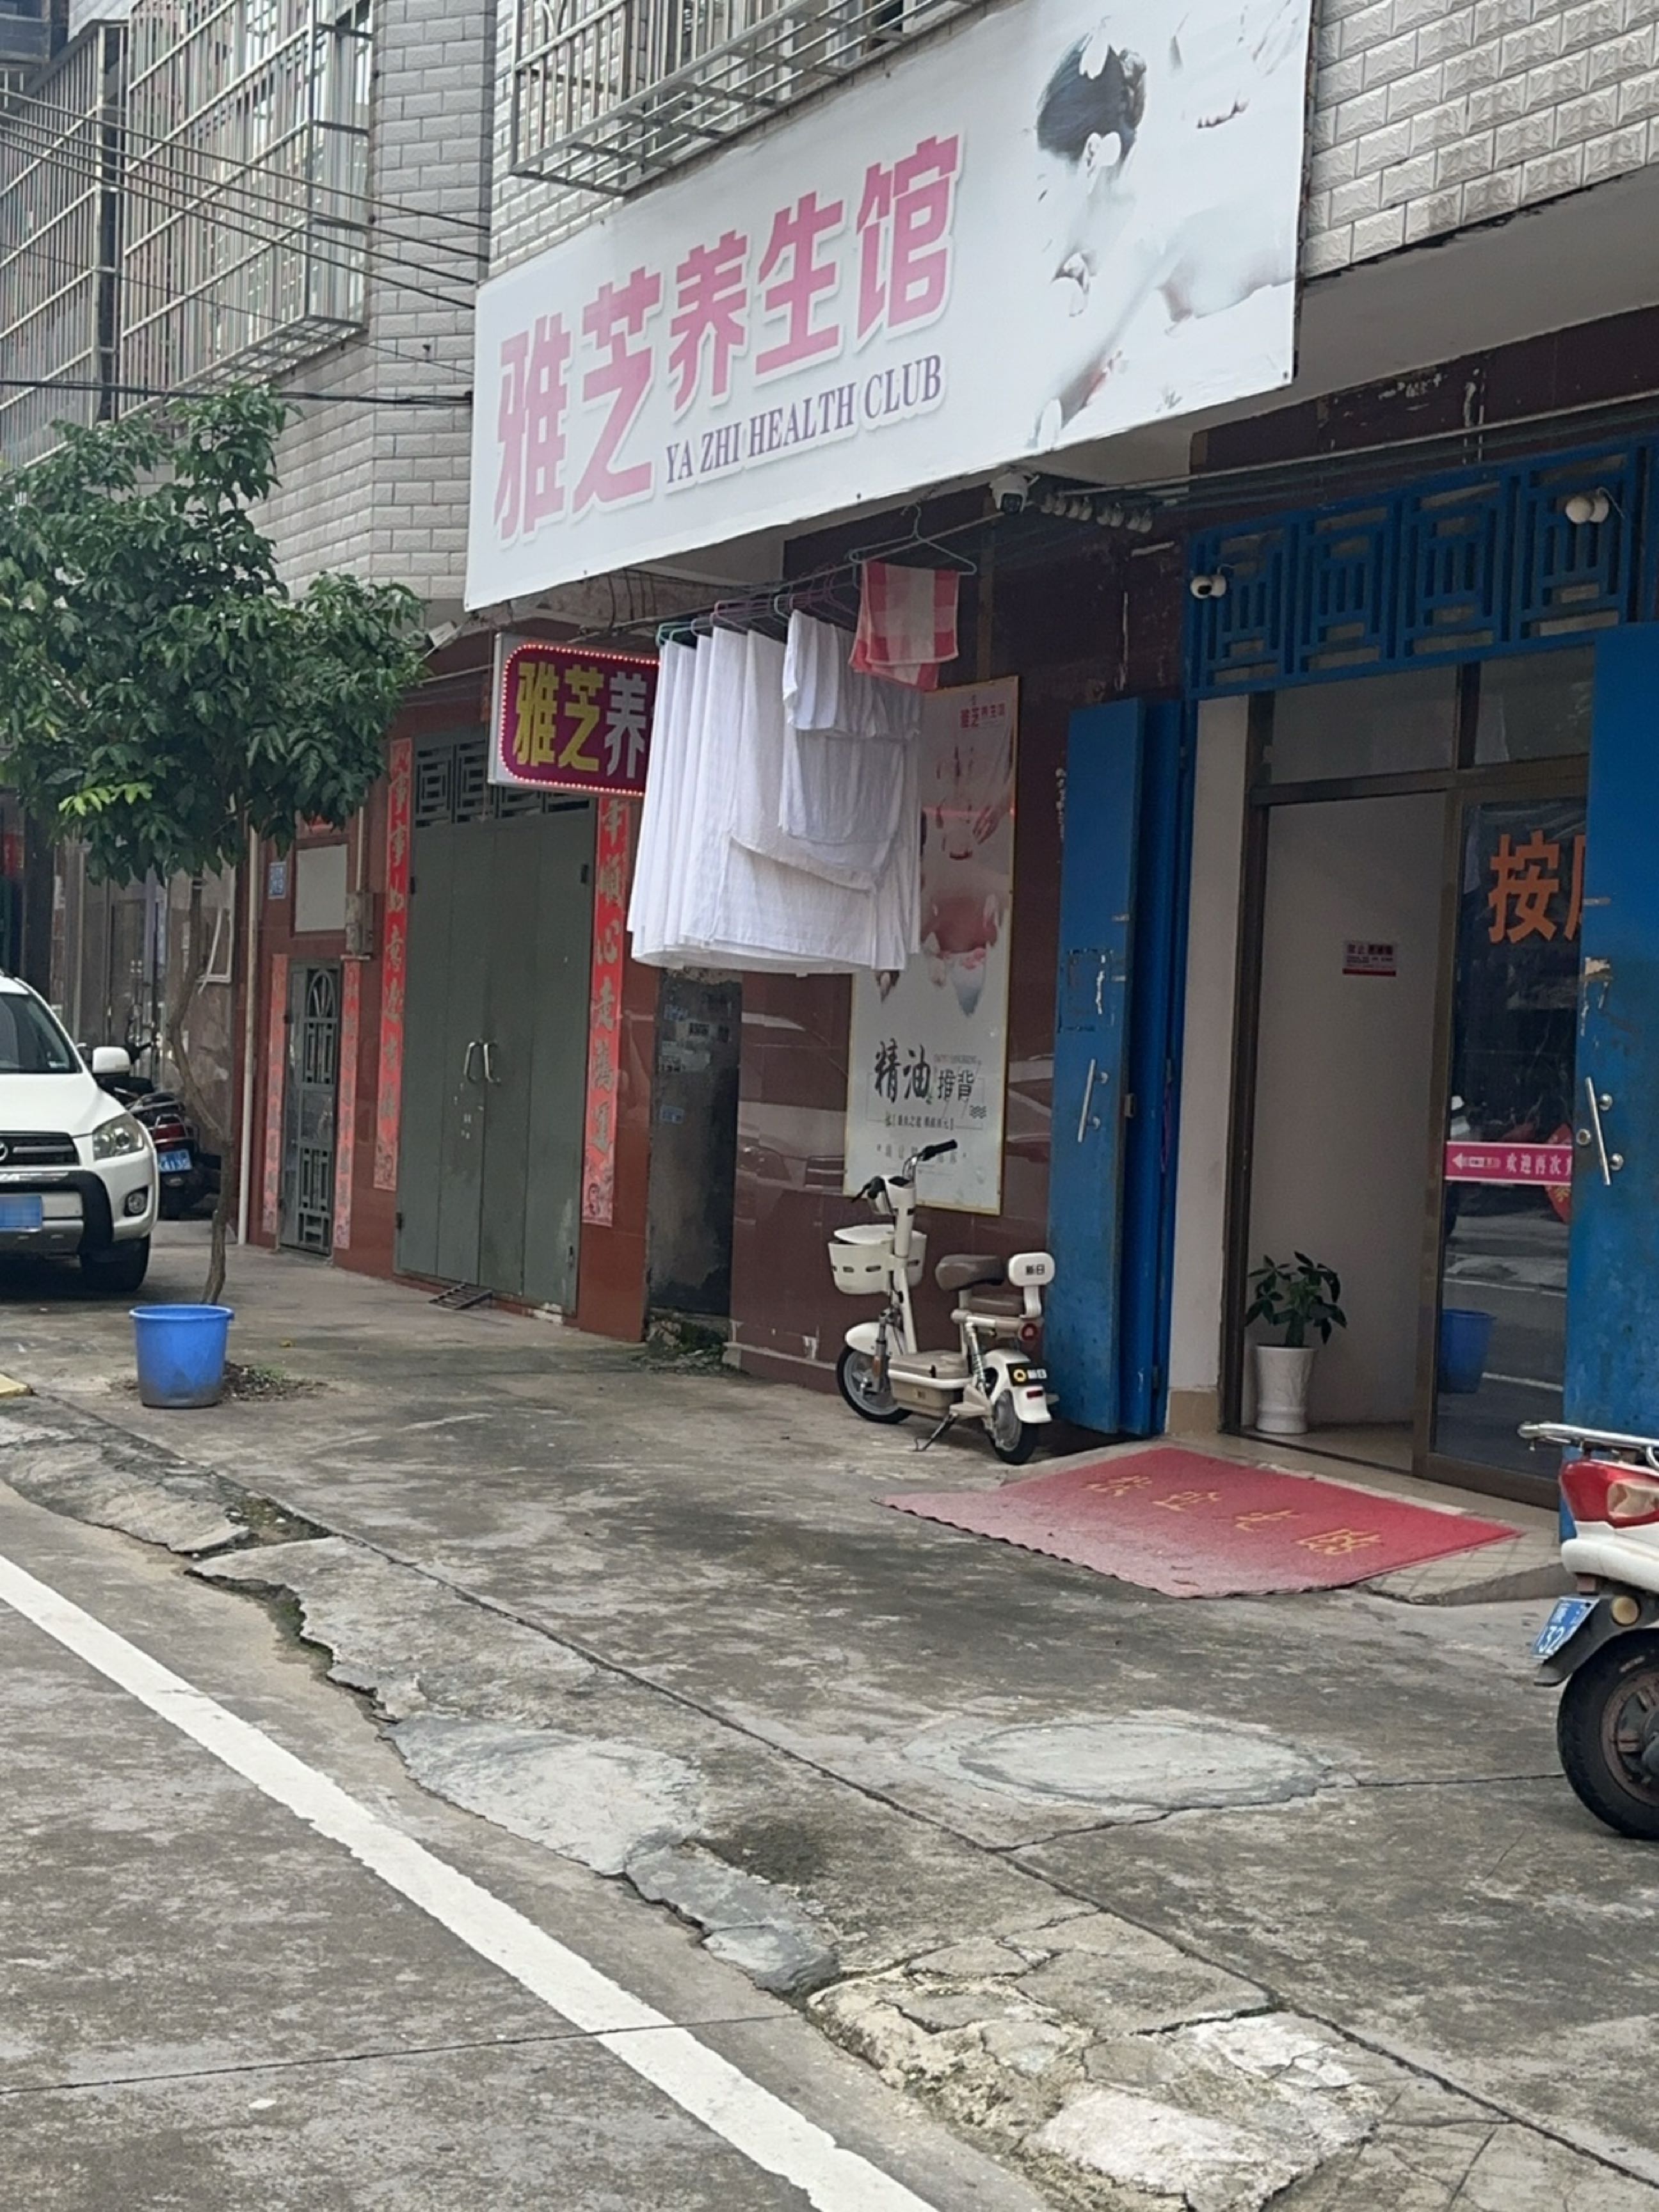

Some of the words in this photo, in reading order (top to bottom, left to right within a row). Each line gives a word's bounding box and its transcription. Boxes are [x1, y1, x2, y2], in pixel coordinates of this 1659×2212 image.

[495, 134, 959, 540] 雅芝养生馆
[666, 439, 693, 484] YA
[700, 422, 742, 474] ZHI
[748, 381, 857, 458] HEALTH
[864, 354, 941, 419] CLUB
[513, 661, 647, 779] 雅芝养
